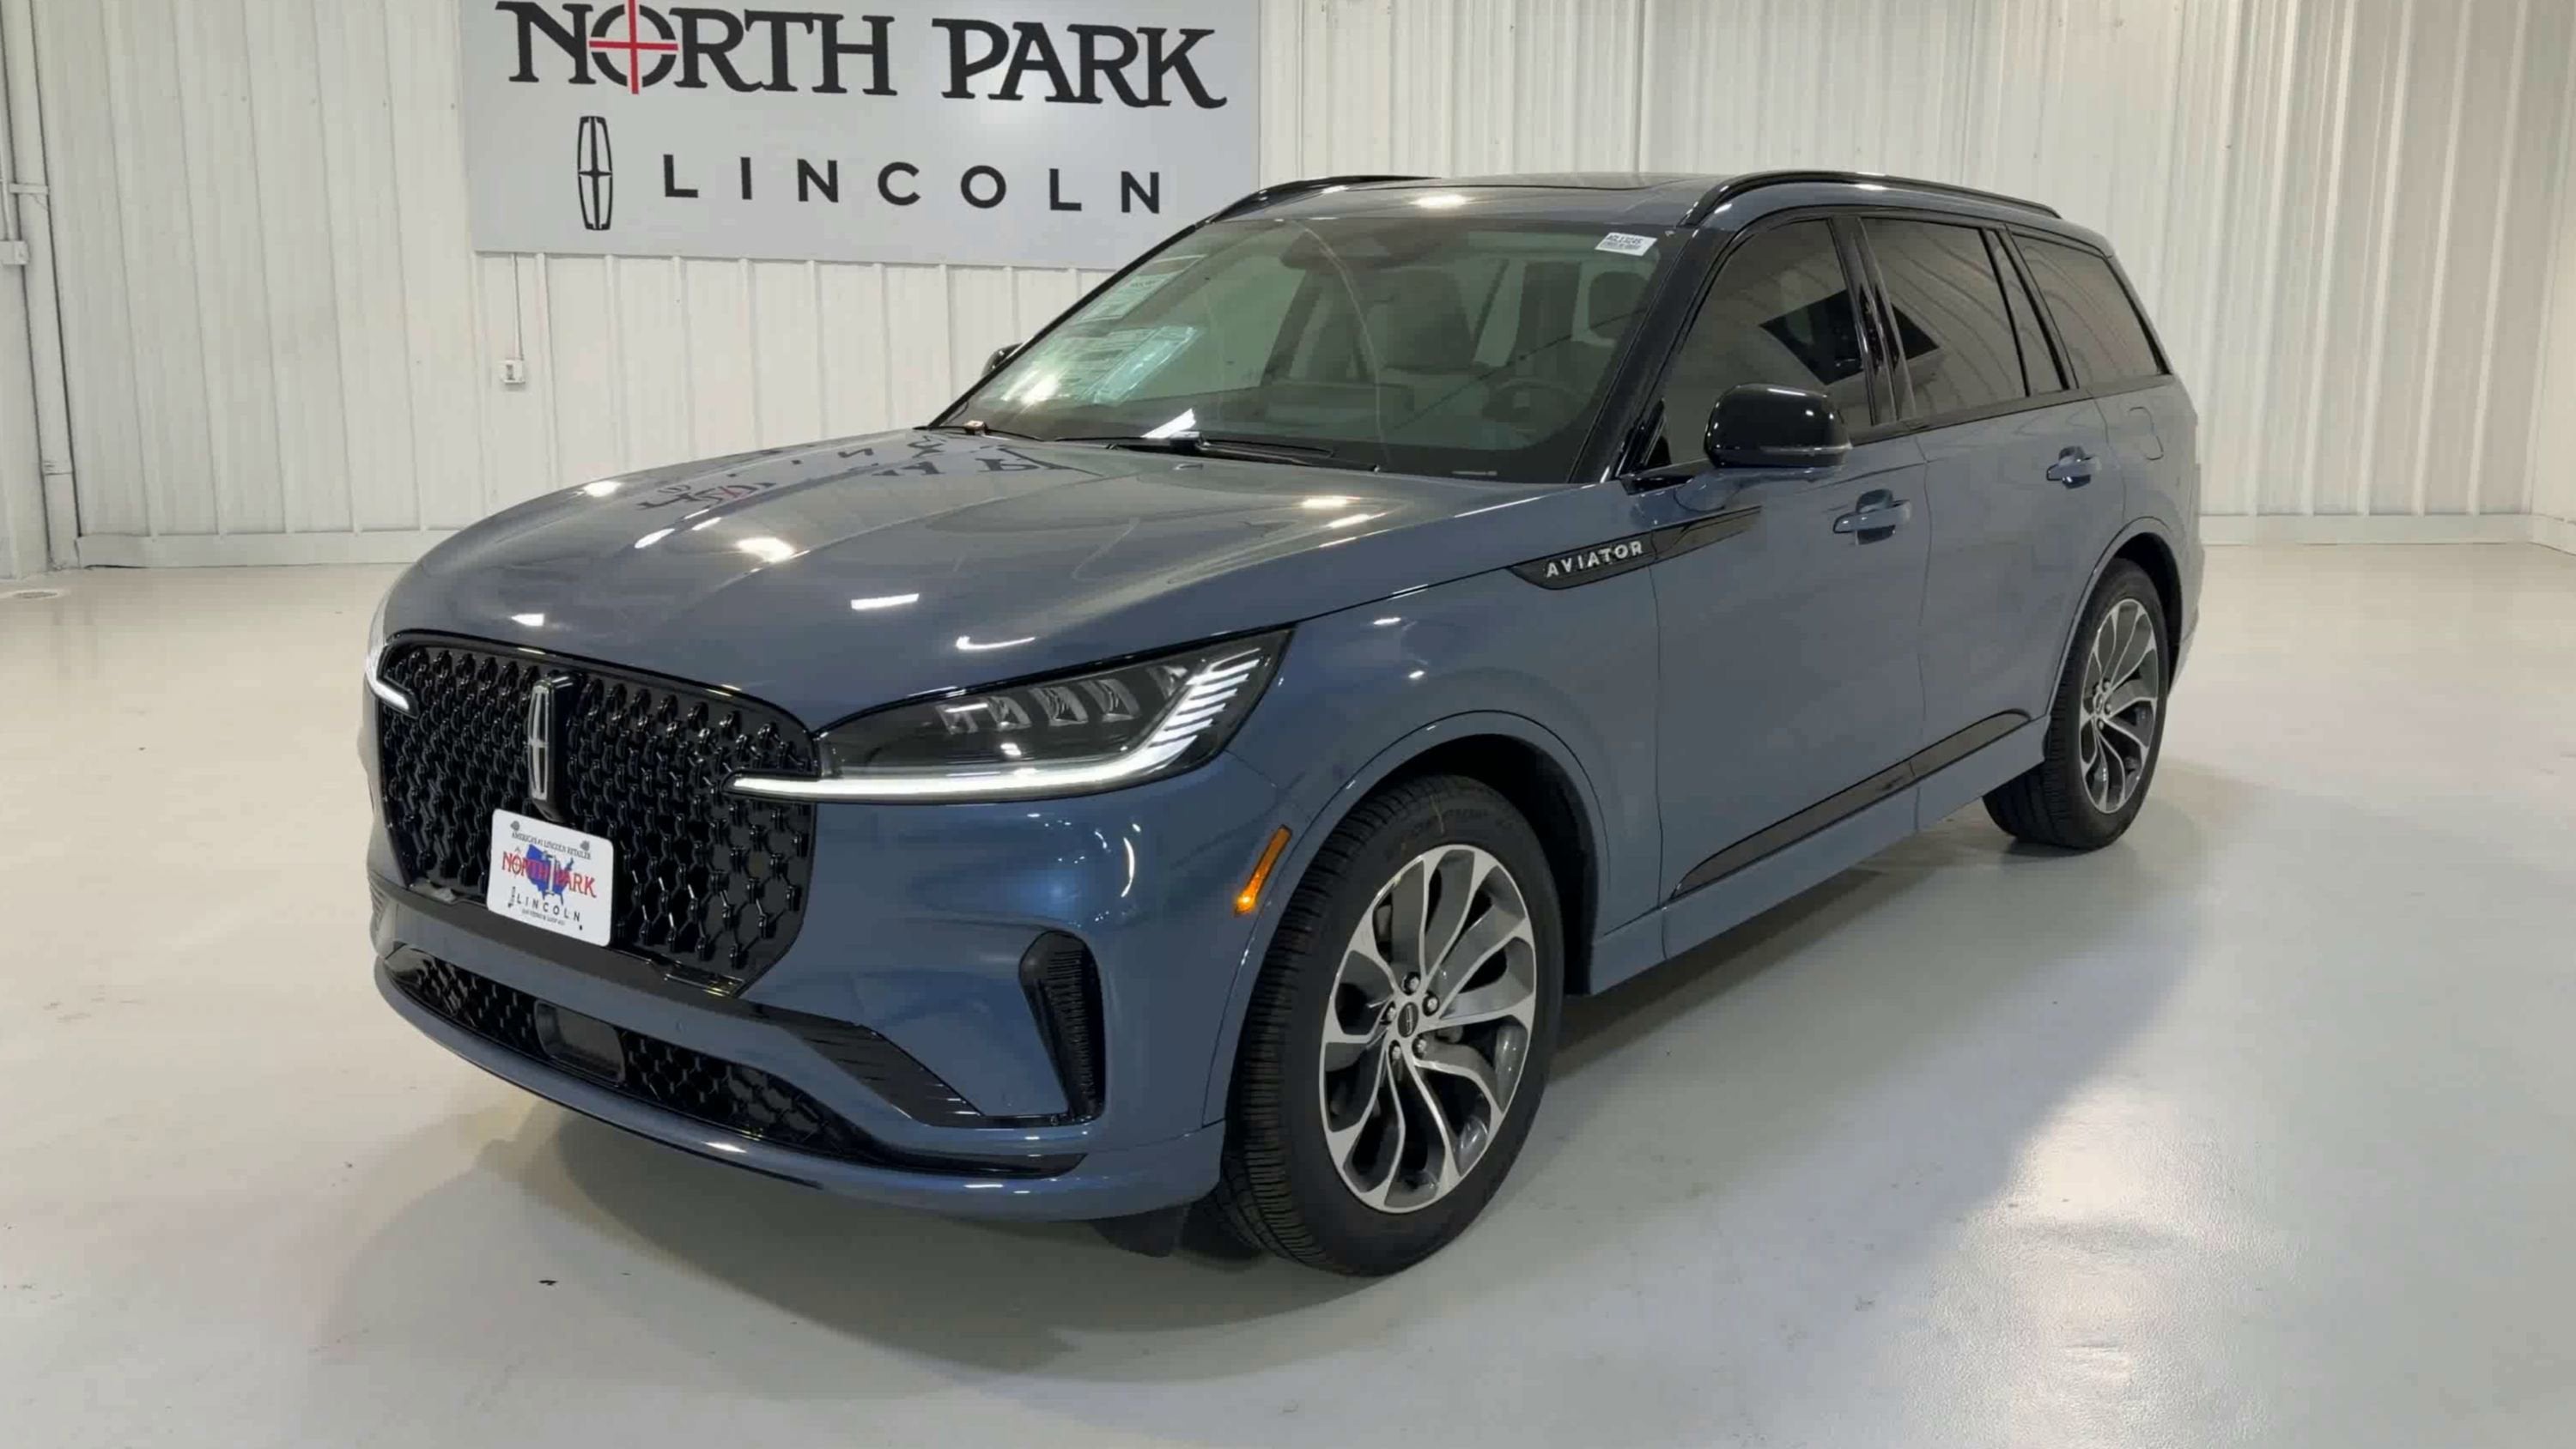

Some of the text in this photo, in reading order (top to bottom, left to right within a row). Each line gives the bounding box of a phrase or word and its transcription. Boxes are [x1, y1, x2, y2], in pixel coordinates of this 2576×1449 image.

[495, 1, 1228, 109] NORTH PARK
[664, 155, 1160, 214] LINCOLN
[1546, 540, 1643, 578] AVIATOR
[501, 851, 597, 898] NORTH PARK
[516, 894, 580, 922] LINCOLN
